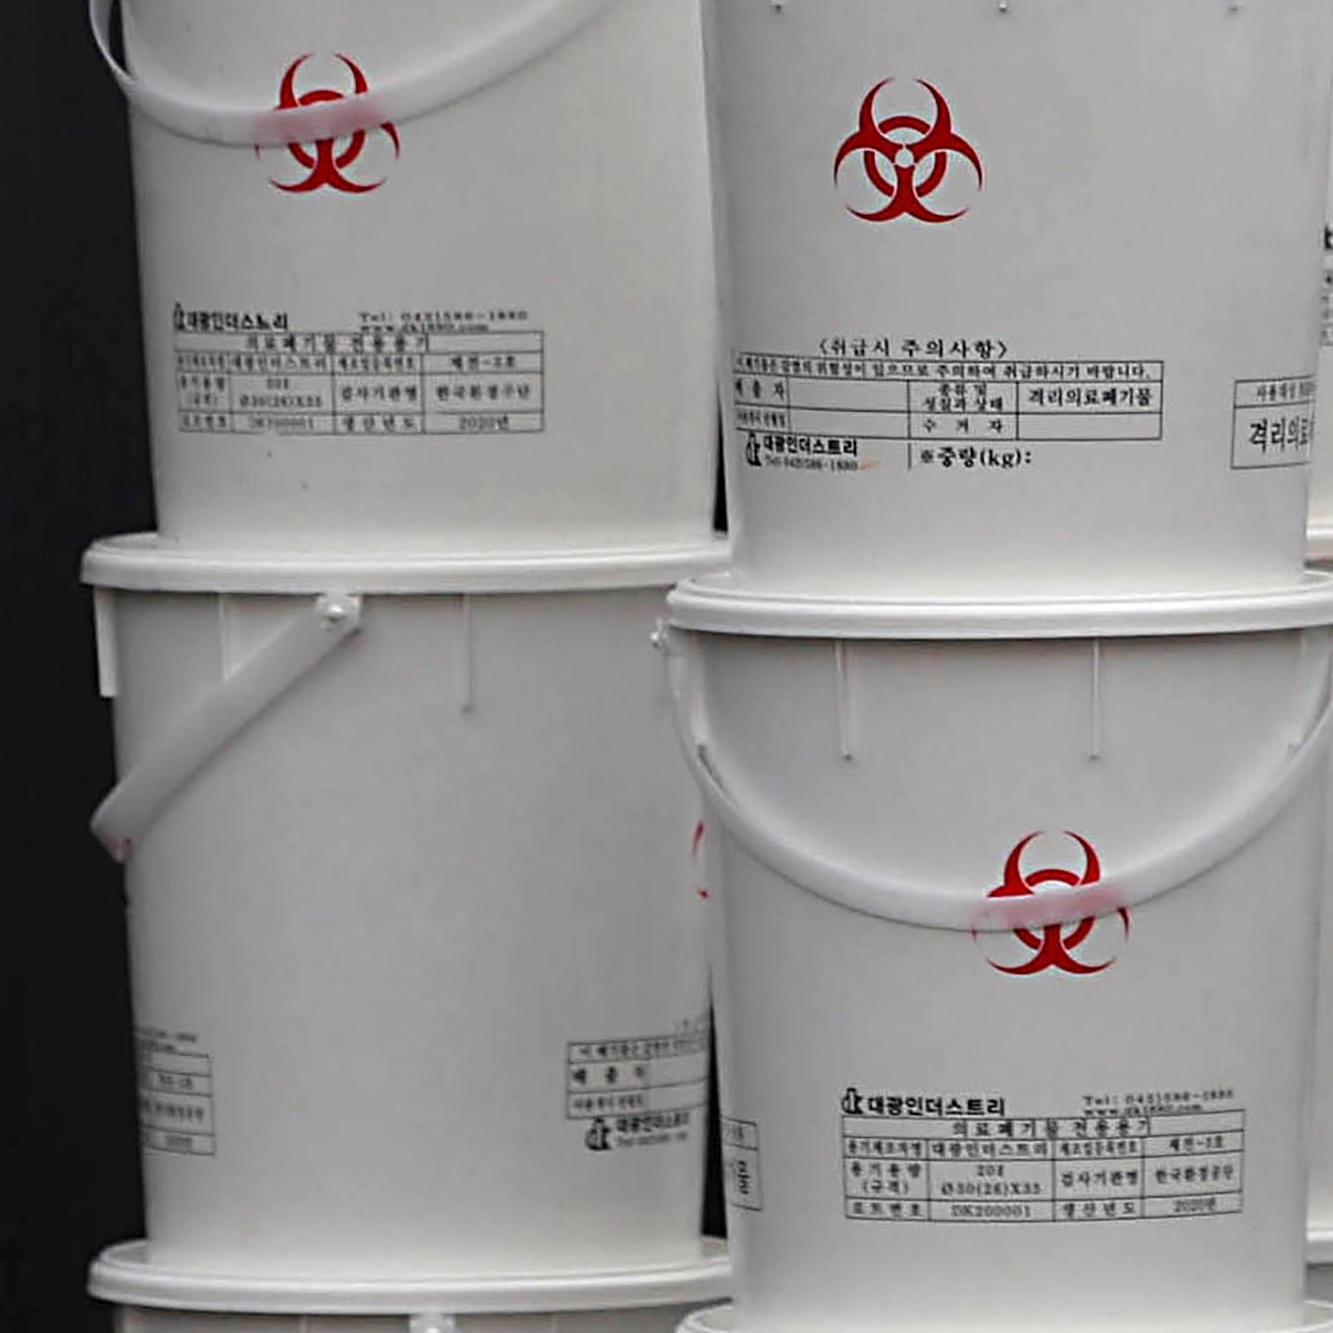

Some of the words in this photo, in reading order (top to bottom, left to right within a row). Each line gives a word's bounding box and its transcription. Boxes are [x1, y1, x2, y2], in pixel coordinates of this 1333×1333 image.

[937, 364, 995, 378] 주의하여
[1004, 364, 1080, 378] 취급하시기
[1029, 388, 1152, 407] 격리의료폐기물
[763, 436, 857, 457] 대광인더스트리
[868, 1096, 1005, 1116] 대광인더스트리
[932, 1142, 1048, 1157] 대광인더스트리
